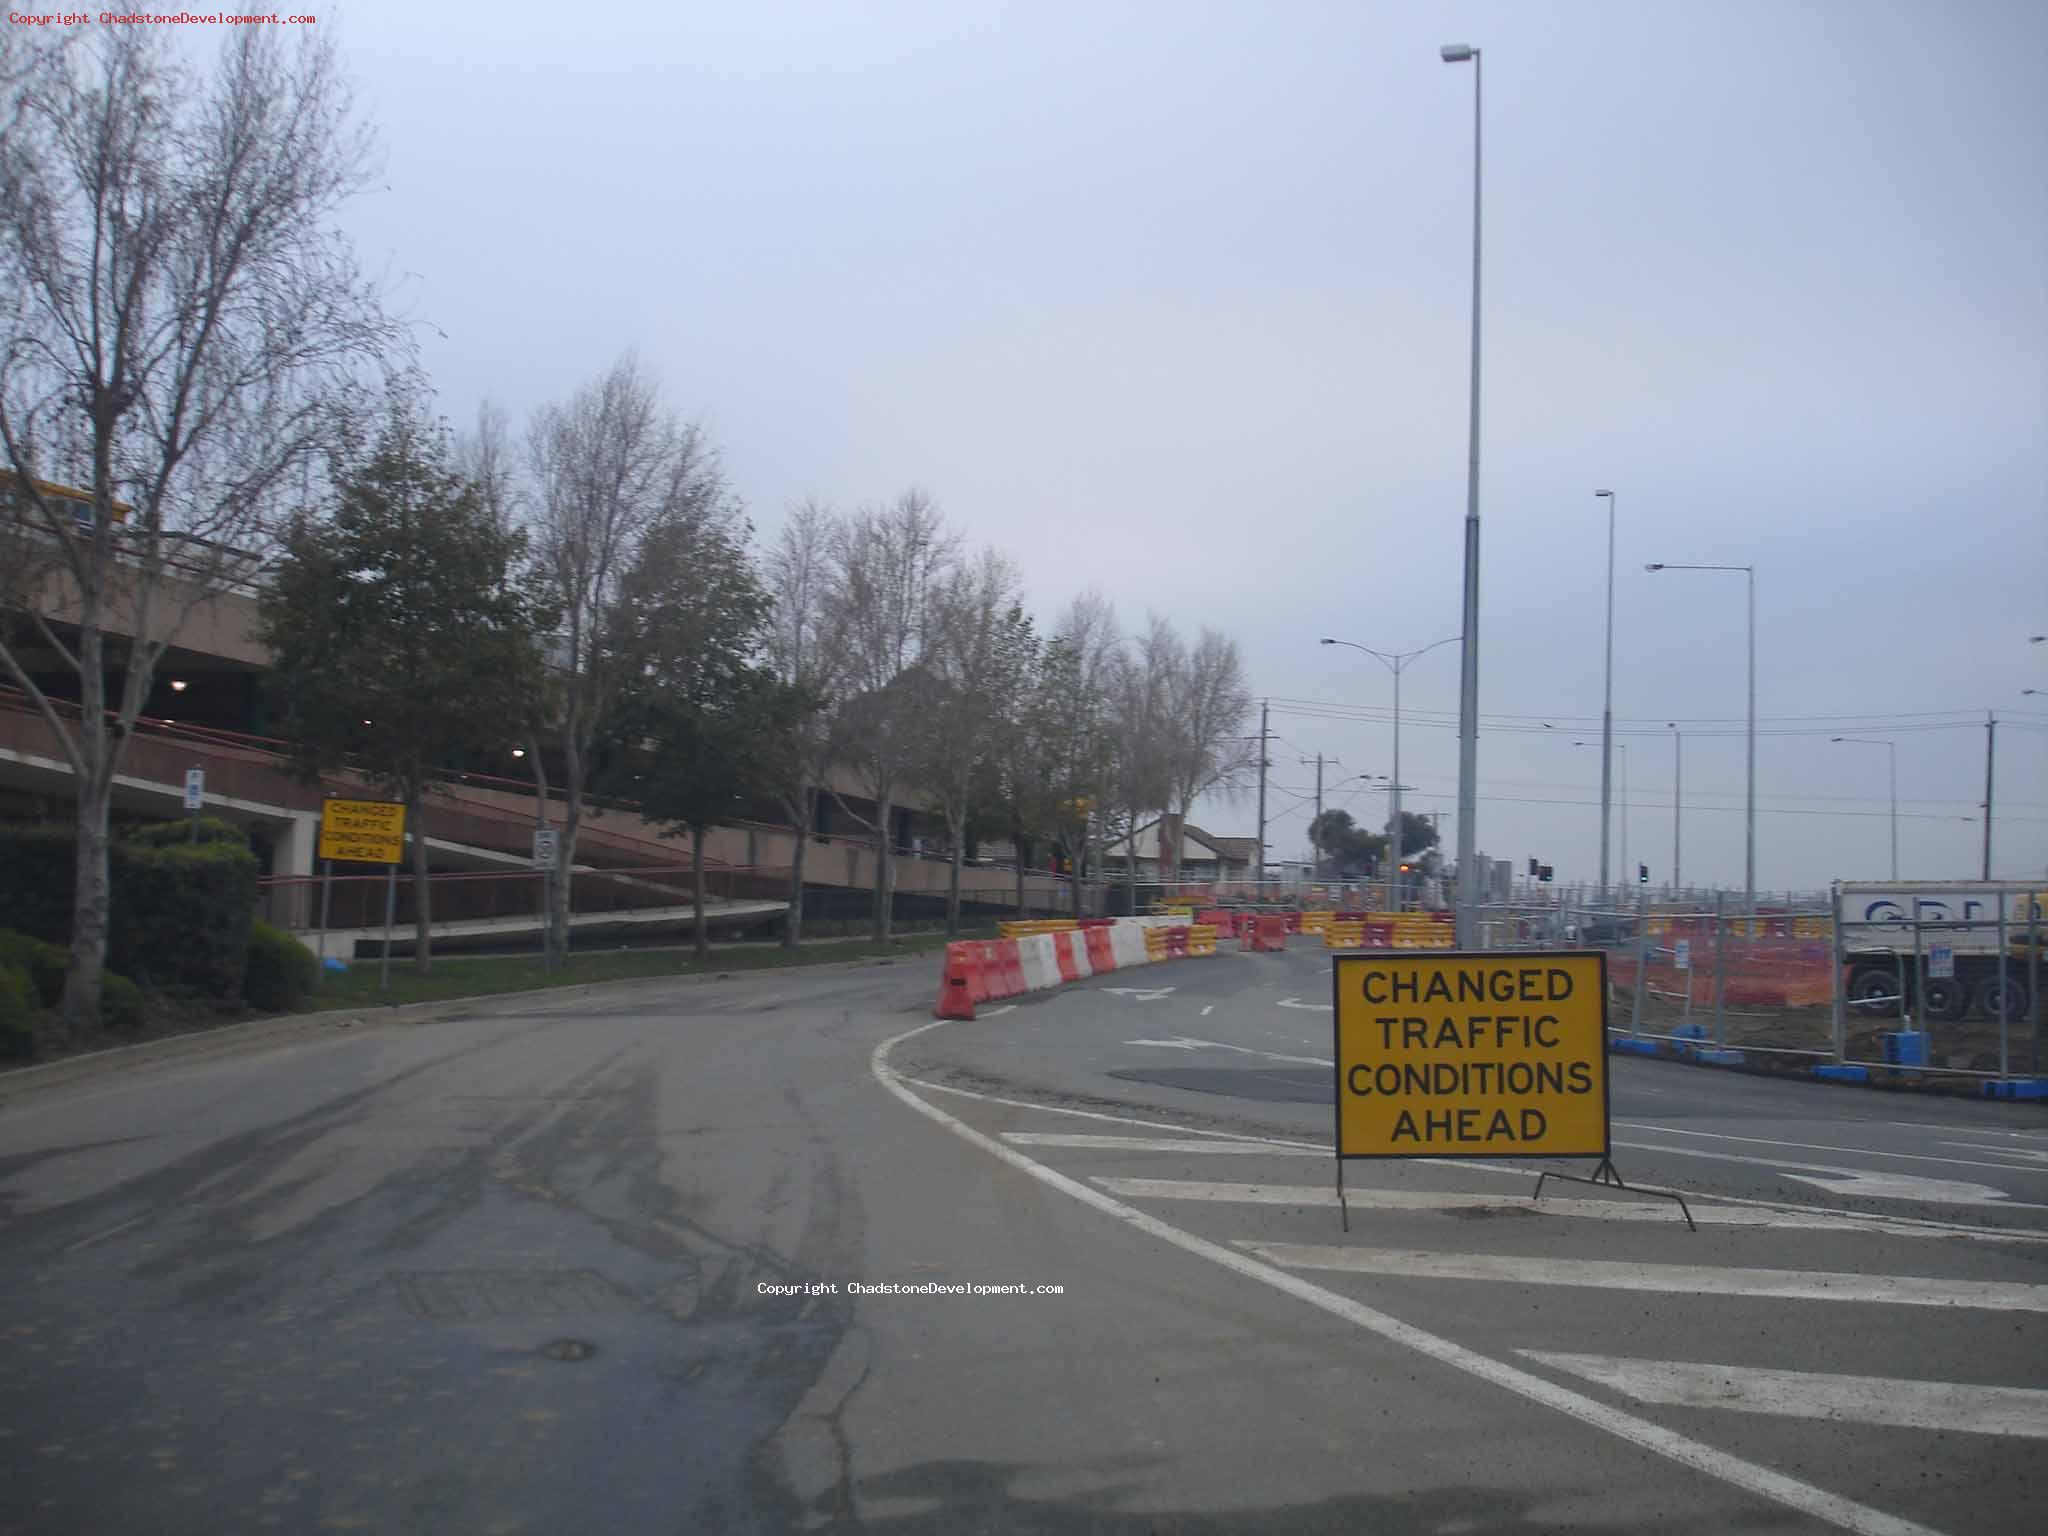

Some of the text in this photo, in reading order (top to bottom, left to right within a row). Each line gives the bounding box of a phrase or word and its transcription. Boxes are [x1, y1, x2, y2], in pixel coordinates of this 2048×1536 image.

[325, 831, 400, 847] CONDITIONS
[335, 816, 392, 832] TRAFFIC
[336, 847, 385, 859] AHEAD
[1362, 968, 1574, 1004] CHANGED
[1375, 1015, 1560, 1050] TRAFFIC
[1347, 1061, 1593, 1097] CONDITIONS
[1390, 1108, 1548, 1143] AHEAD
